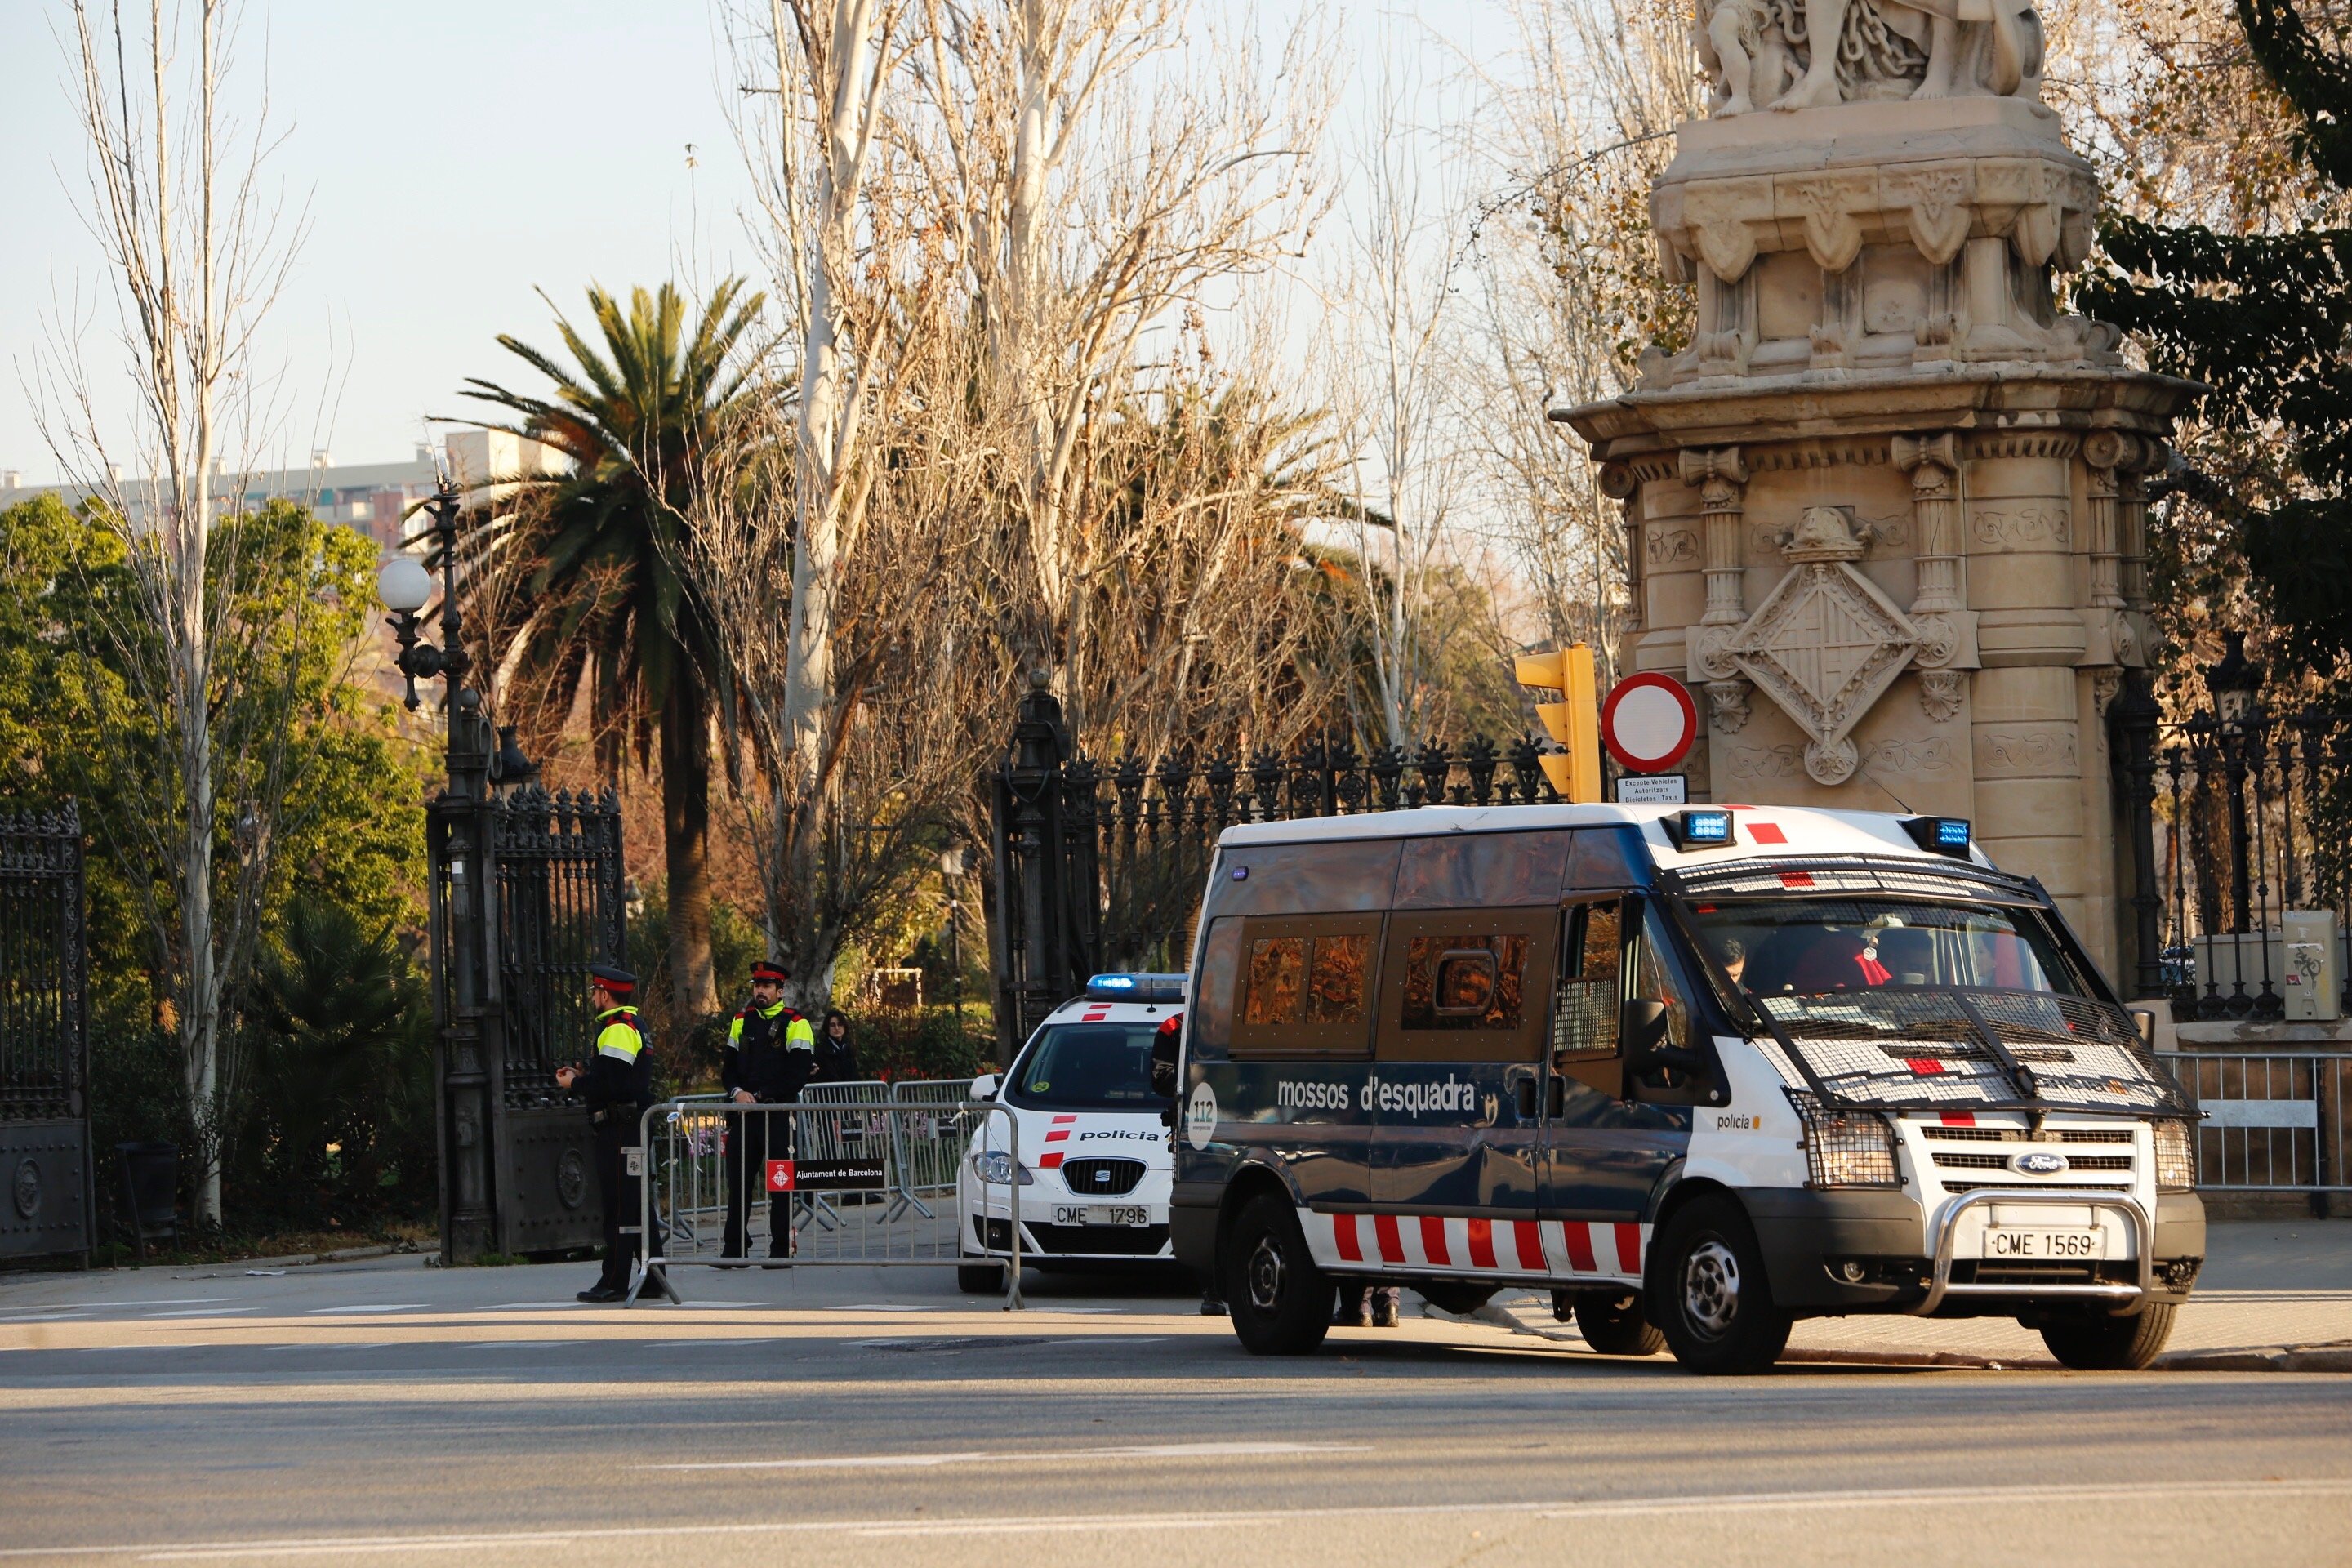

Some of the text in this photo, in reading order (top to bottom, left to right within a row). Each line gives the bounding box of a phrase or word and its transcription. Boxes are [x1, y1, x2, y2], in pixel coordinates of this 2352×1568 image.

[1278, 1073, 1475, 1119] mossos d'esquadra
[1194, 1100, 1213, 1123] 112
[1717, 1113, 1750, 1130] policia
[1080, 1130, 1159, 1142] policia
[2029, 1156, 2058, 1169] Ford
[796, 1170, 836, 1180] Ajuntament
[849, 1169, 883, 1177] Barcelona
[1057, 1207, 1147, 1224] CME 1796
[1997, 1234, 2091, 1255] CME 1569
